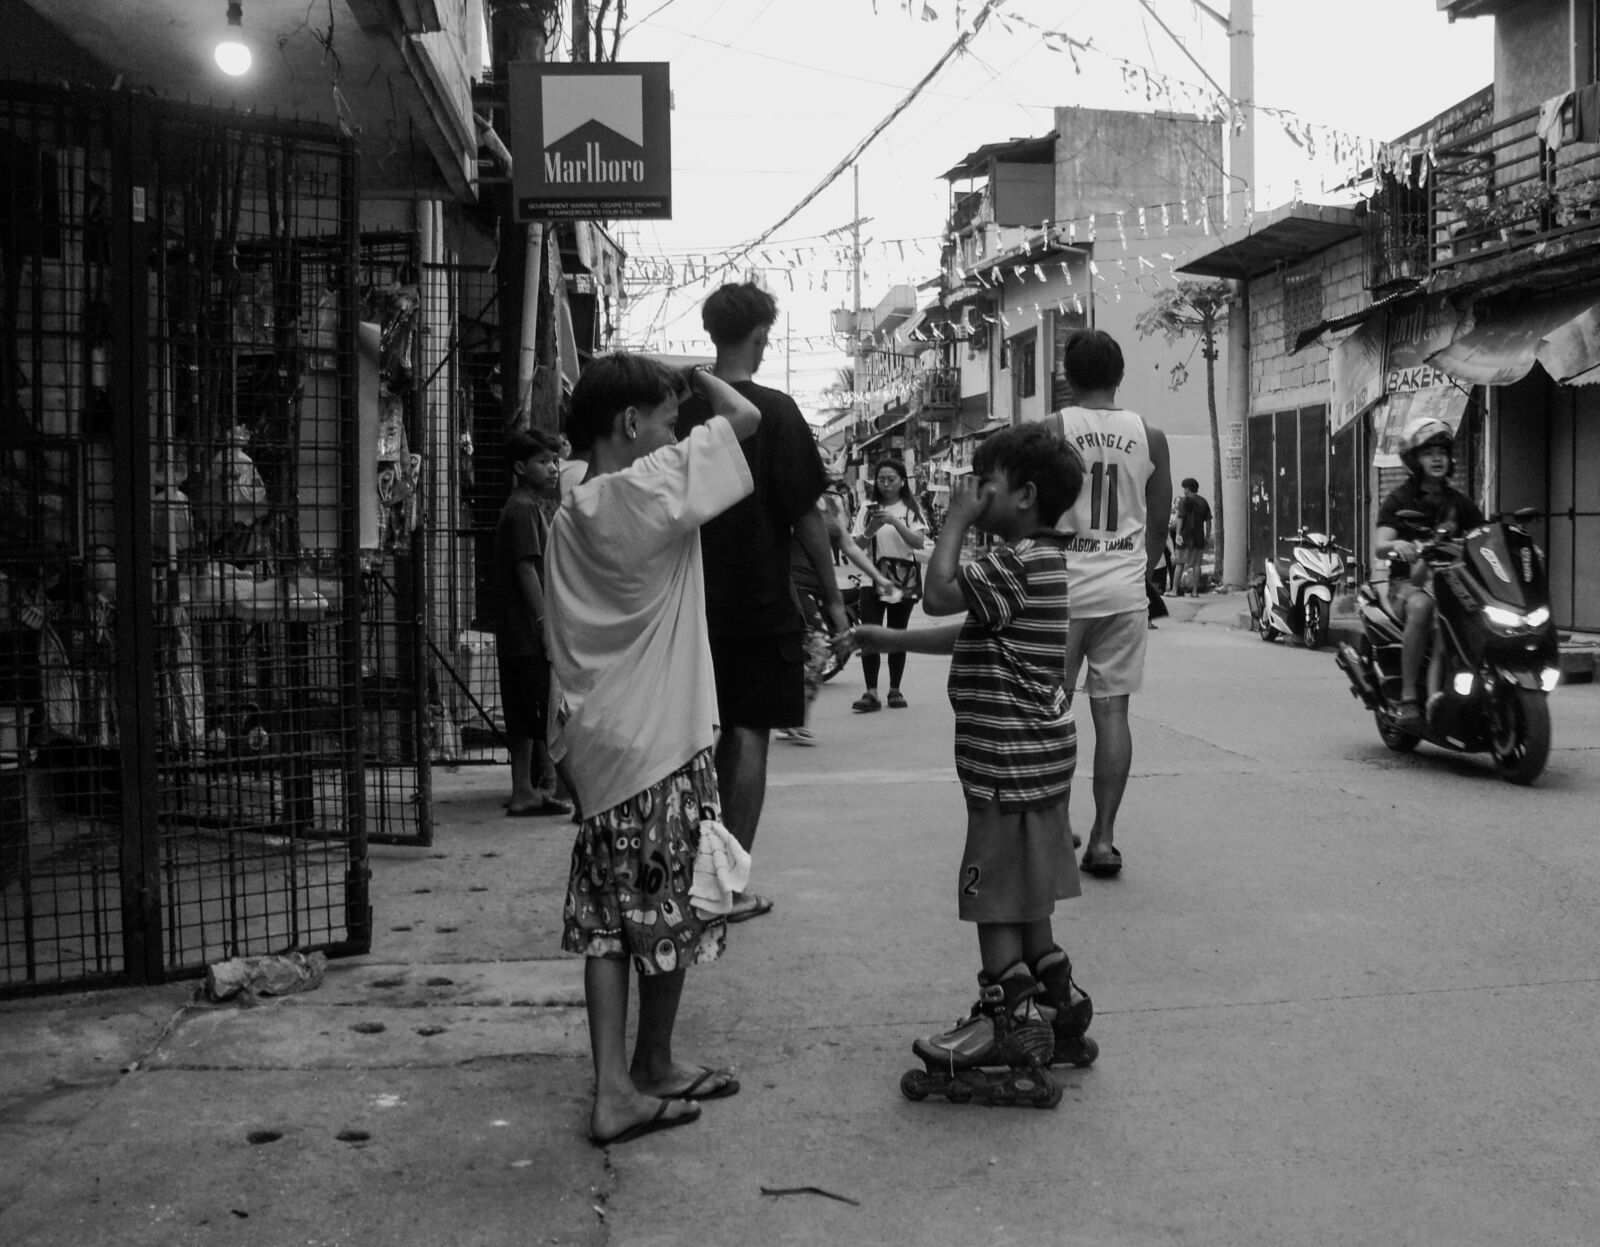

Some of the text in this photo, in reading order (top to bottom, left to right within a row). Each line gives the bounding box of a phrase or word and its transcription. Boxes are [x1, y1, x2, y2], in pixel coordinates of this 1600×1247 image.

[544, 142, 644, 183] Marlboro
[1076, 432, 1137, 454] PRINGLE
[1090, 461, 1118, 532] 11
[963, 865, 980, 898] 2
